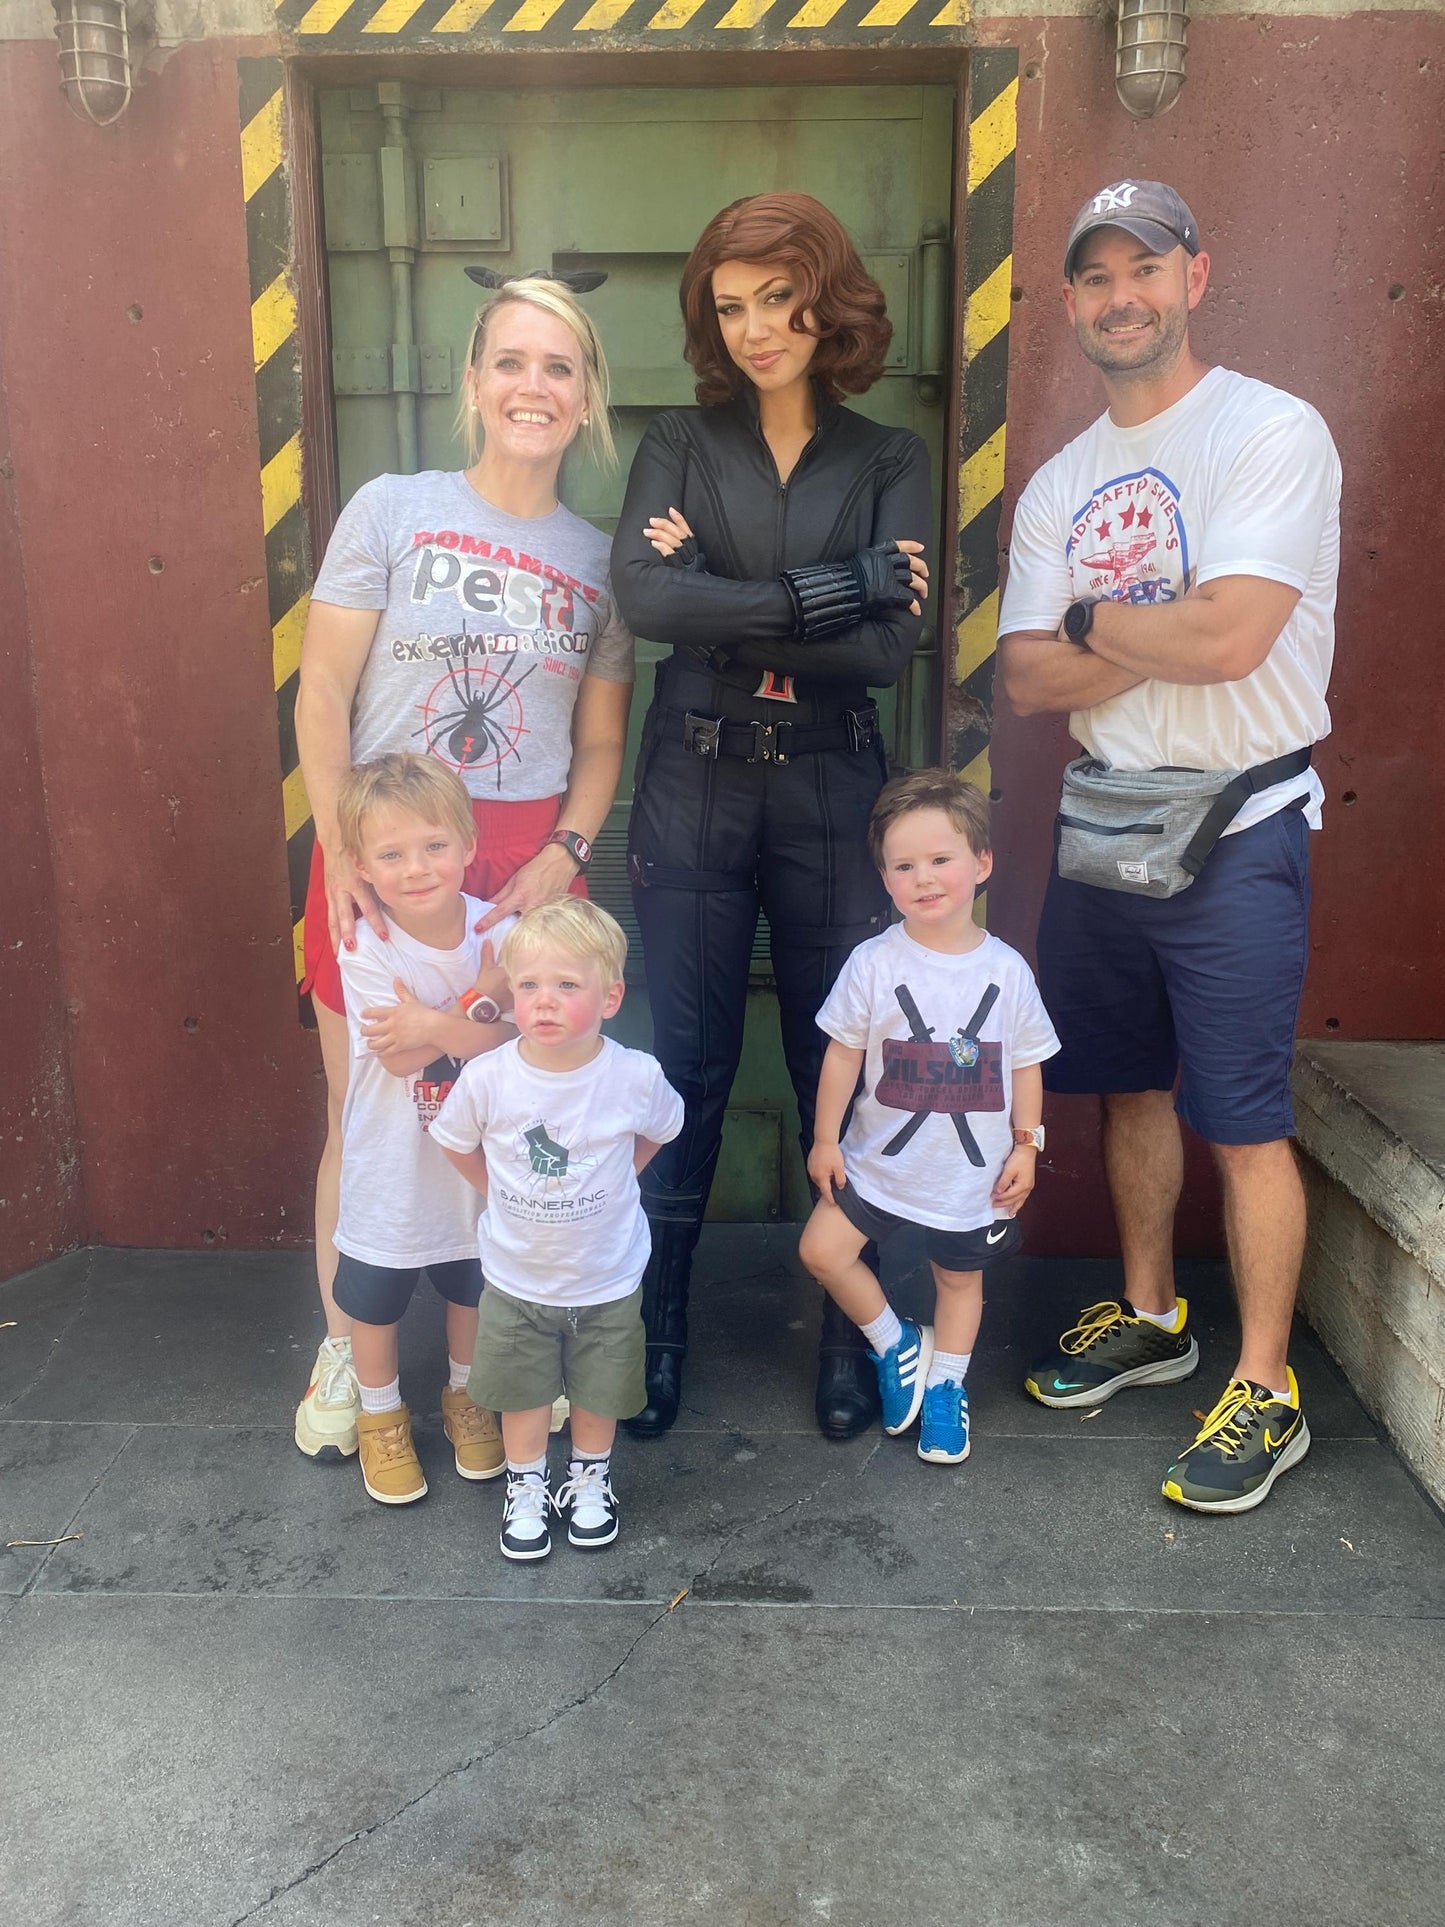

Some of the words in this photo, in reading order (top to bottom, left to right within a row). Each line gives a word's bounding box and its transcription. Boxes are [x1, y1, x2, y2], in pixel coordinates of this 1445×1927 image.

[411, 547, 573, 632] pest
[542, 656, 568, 676] SINCE
[500, 1189, 574, 1210] BANNER
